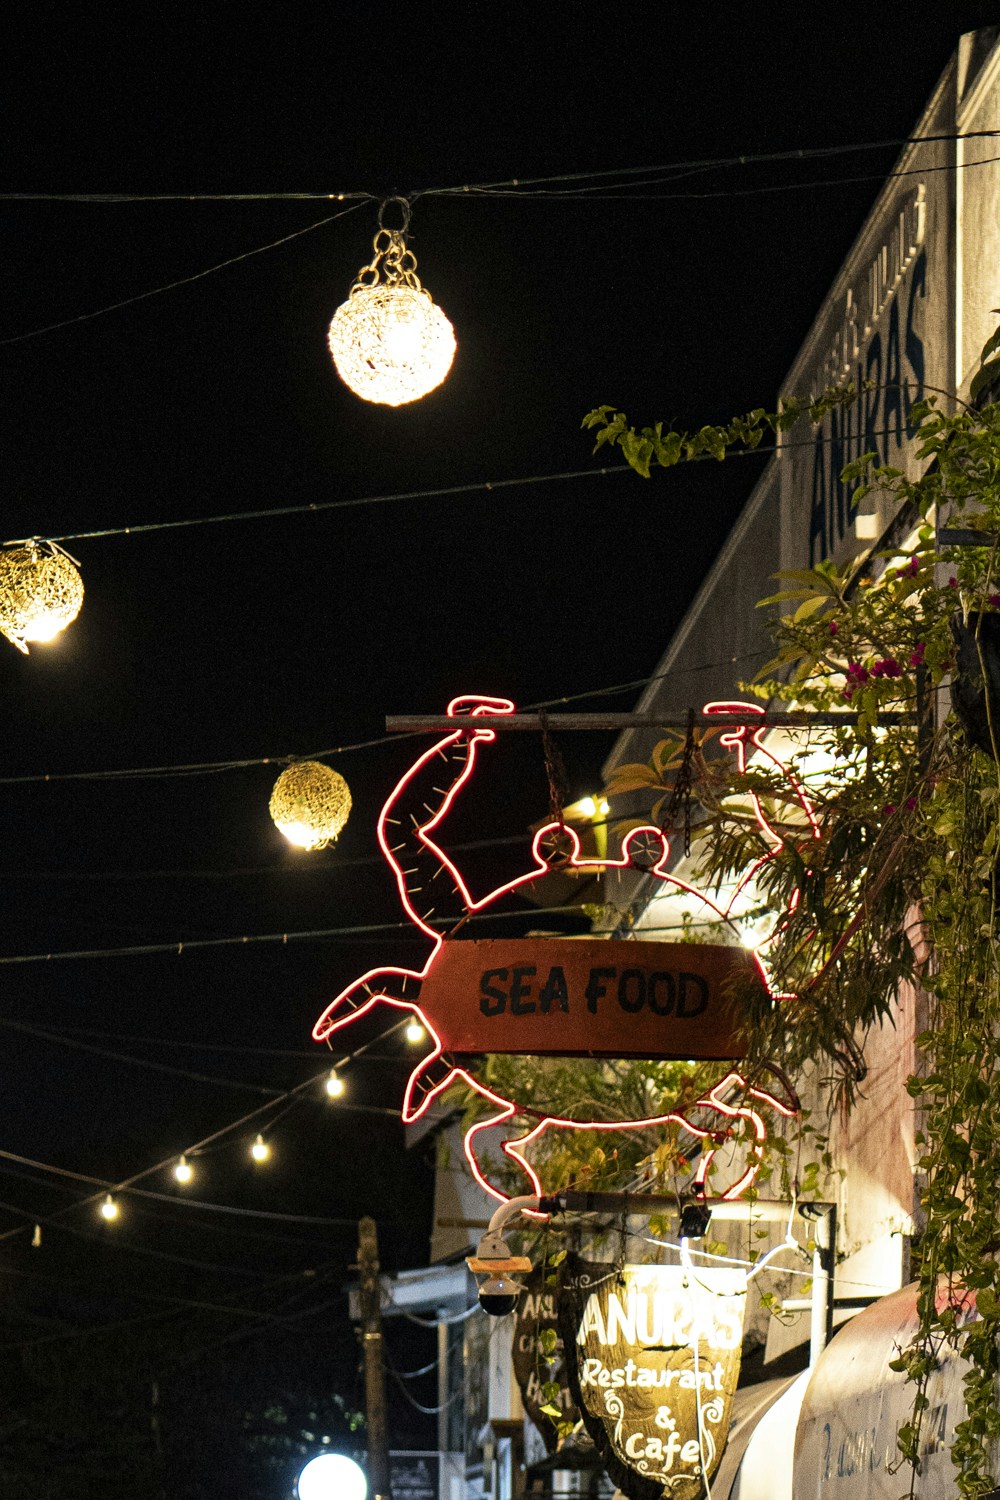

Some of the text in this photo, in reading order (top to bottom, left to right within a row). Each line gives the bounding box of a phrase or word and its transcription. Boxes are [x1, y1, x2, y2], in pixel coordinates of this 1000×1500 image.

[479, 966, 709, 1019] SEA FOOD
[580, 1358, 725, 1391] Restaurant
[654, 1405, 677, 1431] &
[626, 1432, 700, 1472] Cafe
